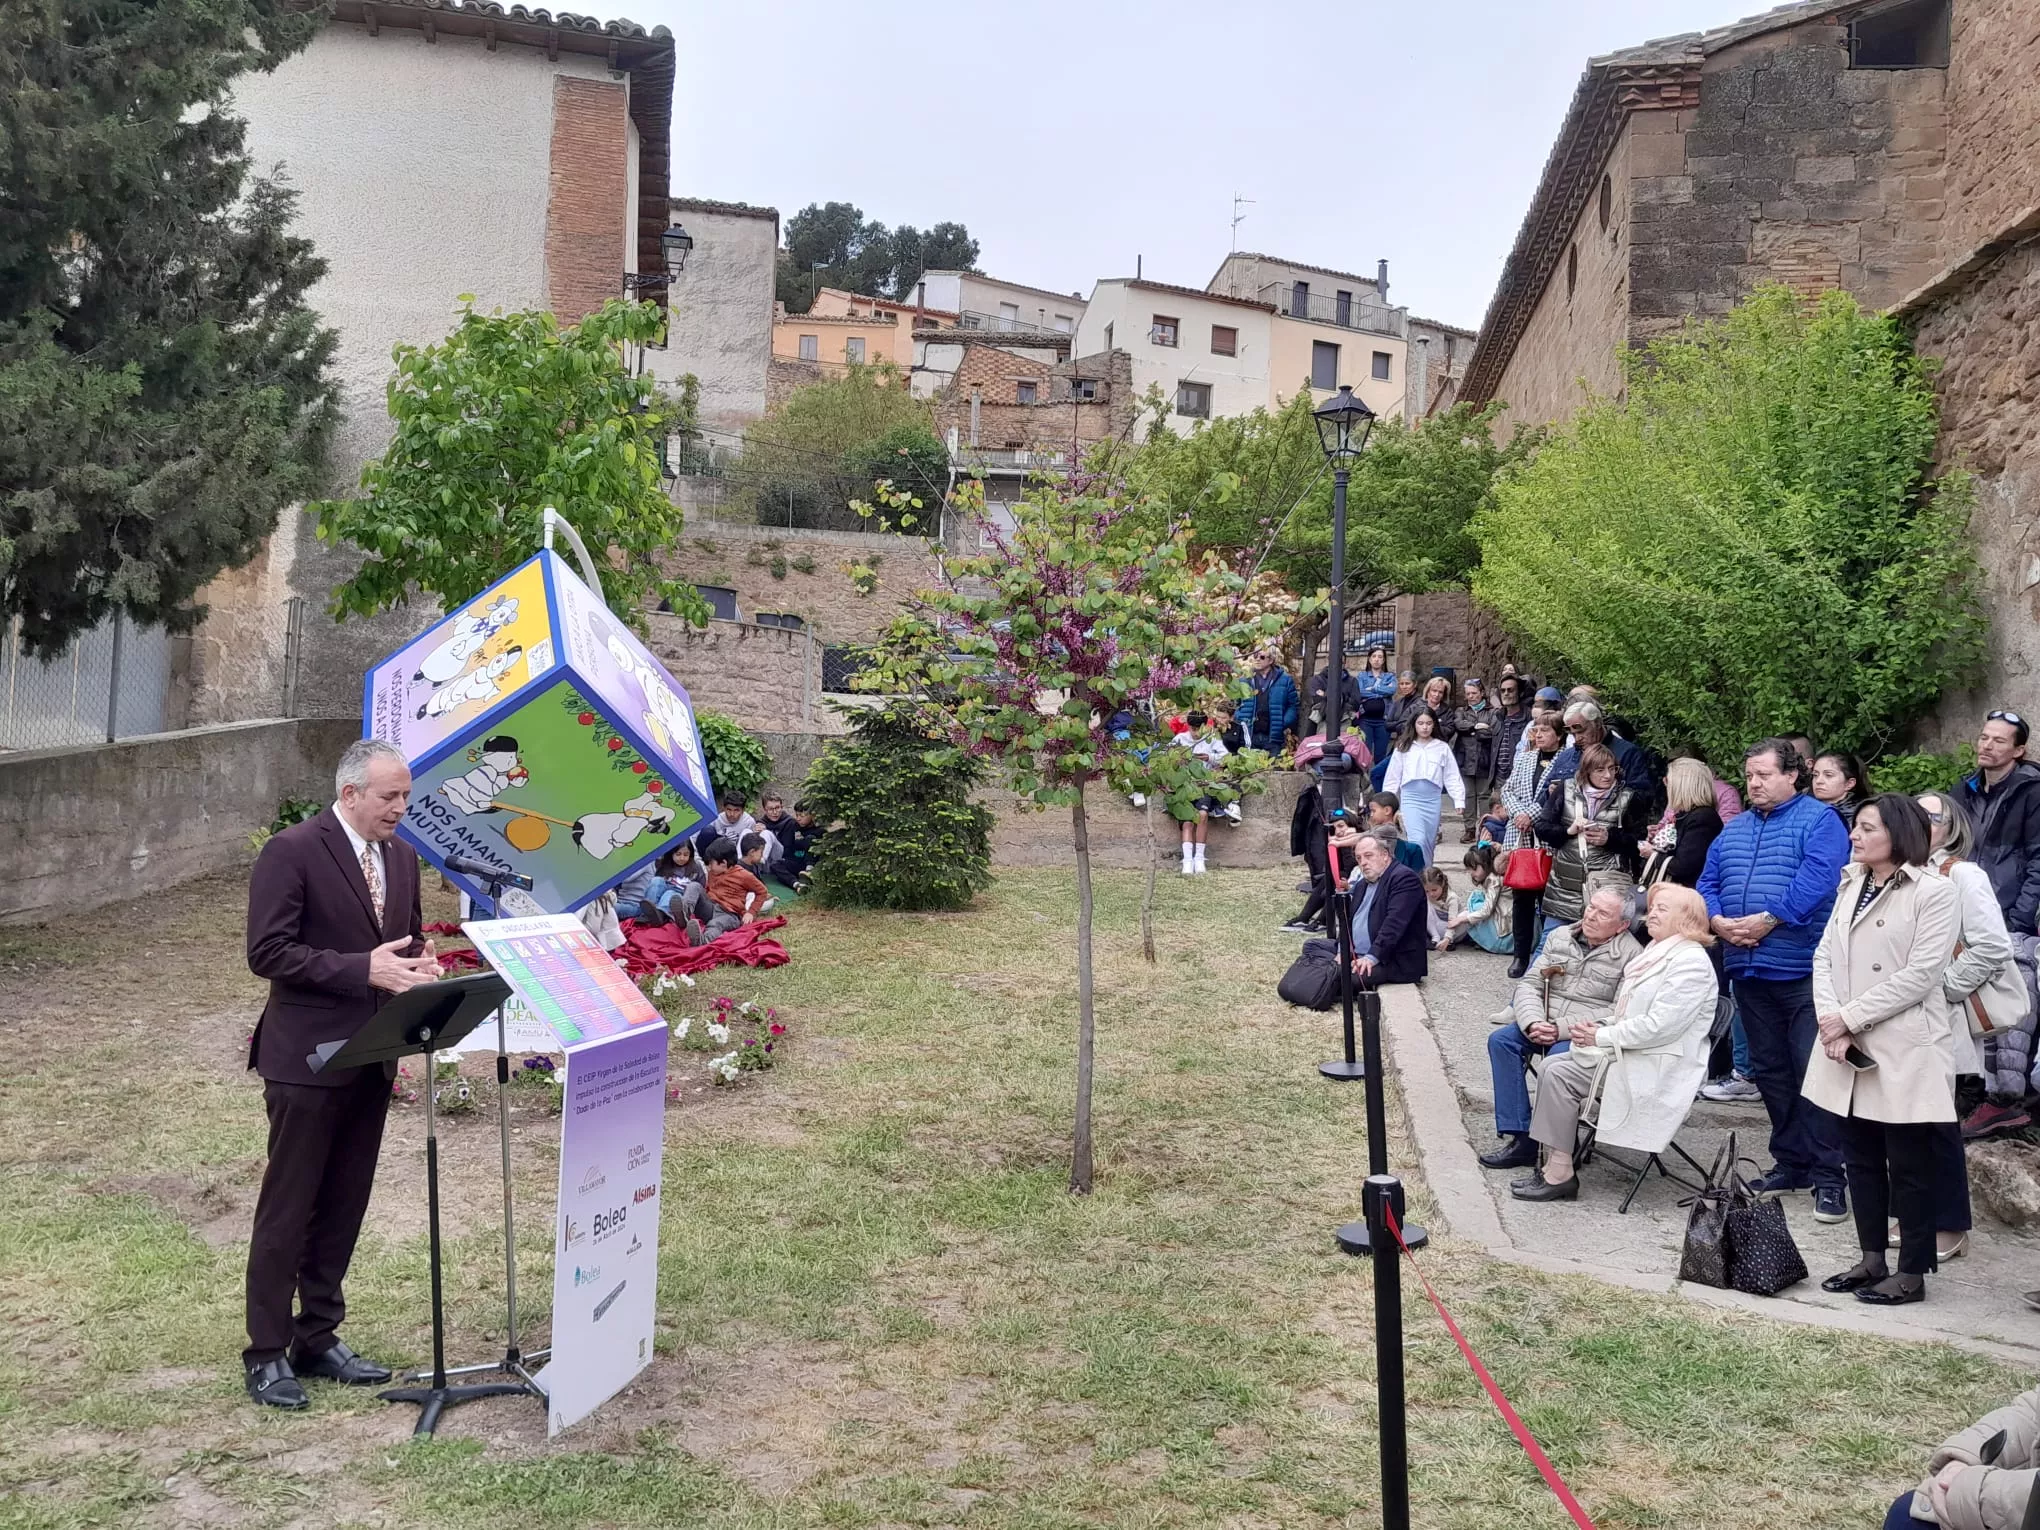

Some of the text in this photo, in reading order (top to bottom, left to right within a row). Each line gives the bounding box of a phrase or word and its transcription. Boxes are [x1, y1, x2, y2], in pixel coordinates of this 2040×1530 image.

[376, 687, 388, 716] UNOS
[391, 667, 402, 747] NOS PERDONAM
[406, 804, 476, 860] MUTUAM
[418, 794, 513, 873] NOS AMAMO
[632, 1184, 656, 1206] Alsina
[593, 1206, 626, 1236] Bolea
[581, 1264, 600, 1284] Bolea
